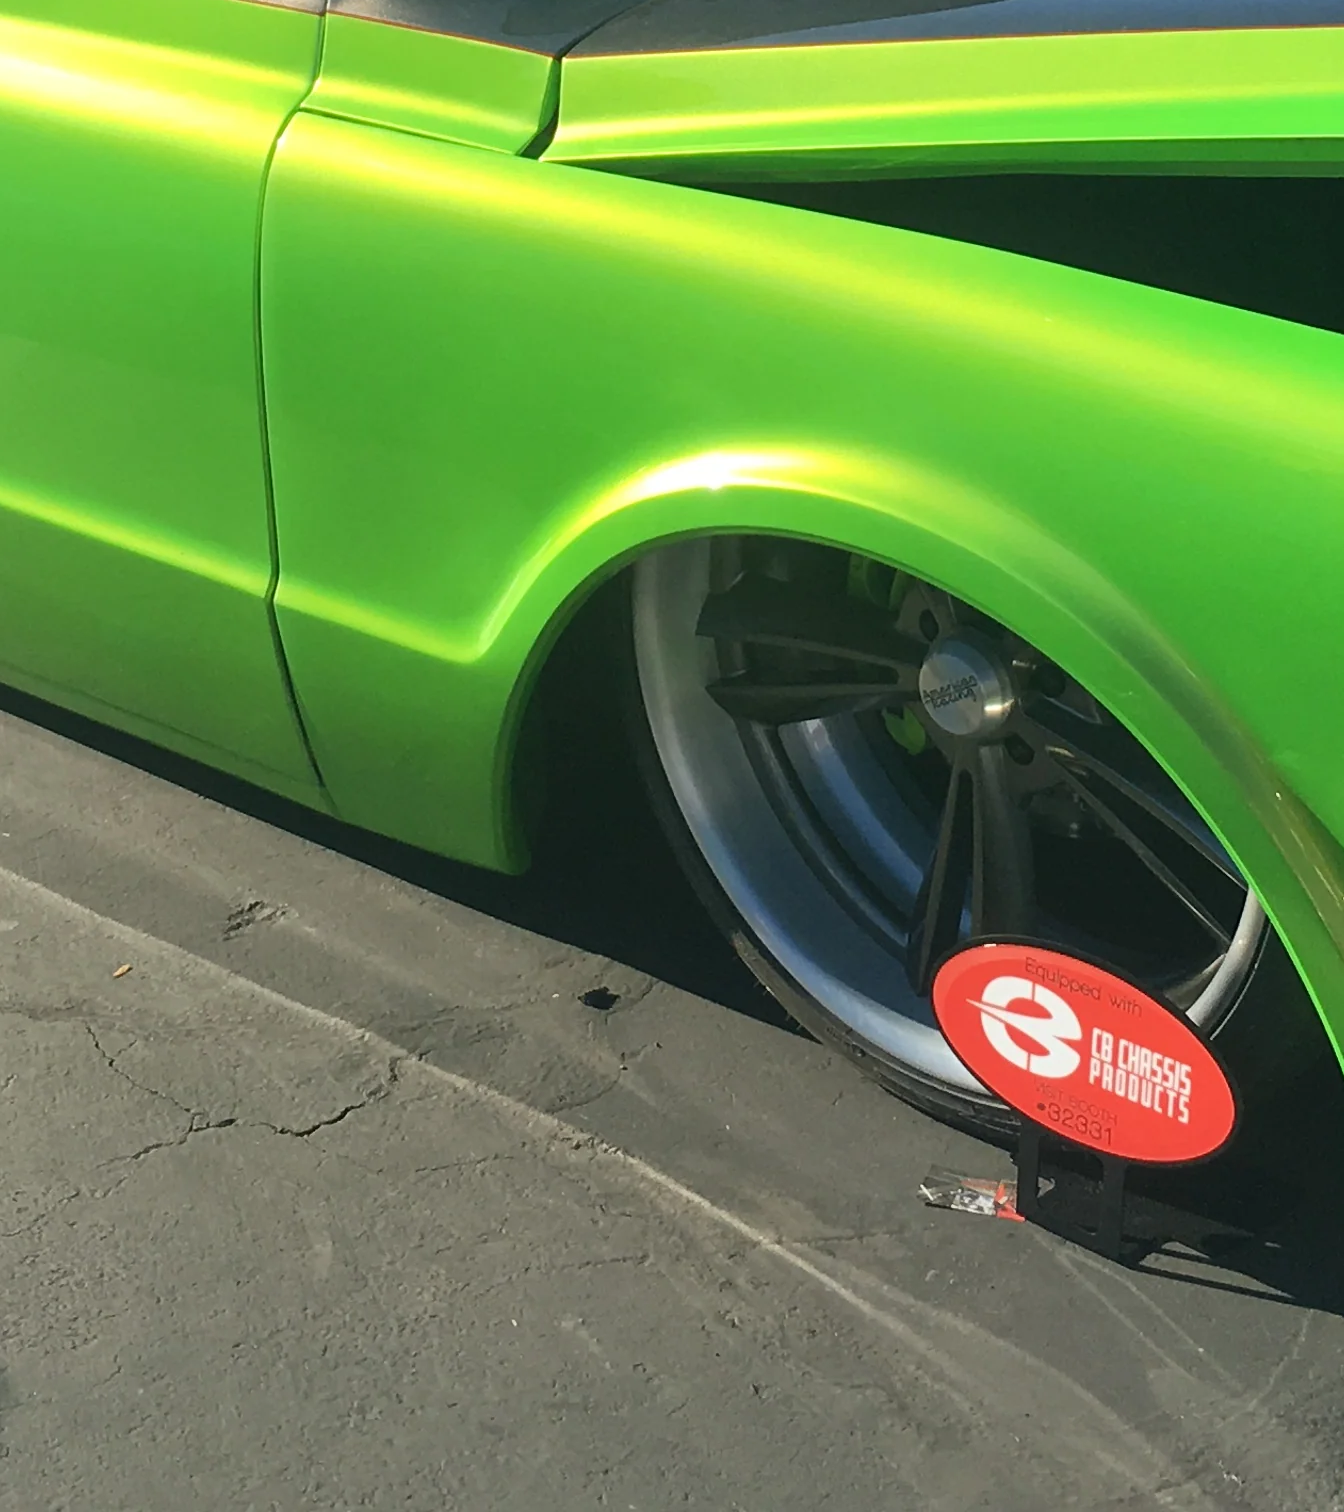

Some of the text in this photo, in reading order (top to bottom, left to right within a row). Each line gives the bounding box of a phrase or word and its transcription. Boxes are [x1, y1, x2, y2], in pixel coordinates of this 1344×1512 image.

[1025, 956, 1144, 1019] Equipped with
[1089, 1057, 1190, 1125] PRODUCTS
[1092, 1027, 1193, 1097] CB CHASSIS
